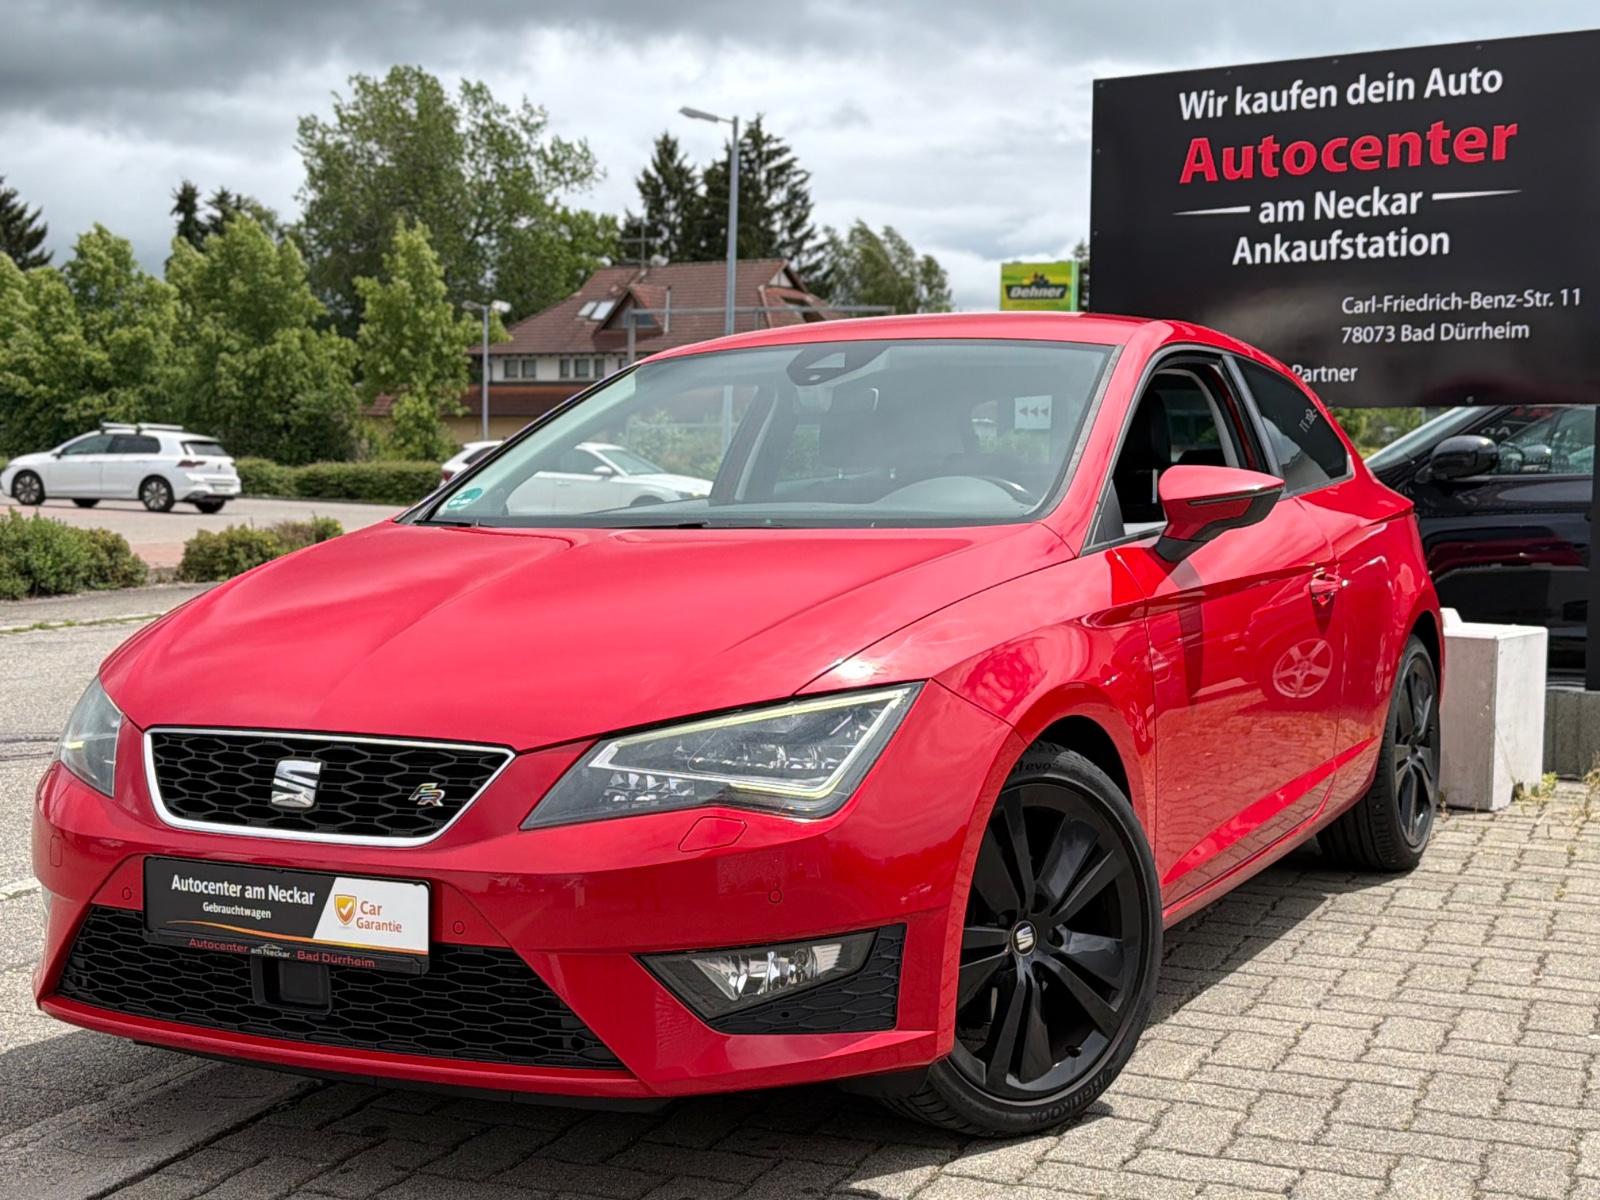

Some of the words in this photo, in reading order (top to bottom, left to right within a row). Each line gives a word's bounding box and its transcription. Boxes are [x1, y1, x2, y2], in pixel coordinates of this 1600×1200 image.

[1179, 89, 1228, 120] Wir
[1235, 79, 1338, 115] kaufen
[1346, 73, 1415, 105] dein
[1423, 66, 1503, 98] Auto
[1179, 120, 1518, 184] Autocenter
[1258, 199, 1305, 224] am
[1314, 185, 1423, 220] Neckar
[1232, 227, 1450, 266] Ankaufstation
[1009, 286, 1064, 298] Dehner
[1341, 289, 1554, 315] Carl-Friedrich-Benz-Str.
[1560, 288, 1581, 306] 11
[1341, 326, 1396, 344] 78073
[1400, 323, 1435, 342] Bad
[1440, 321, 1530, 341] Dürrheim
[1291, 364, 1358, 383] Partner
[171, 874, 242, 897] Autocenter
[244, 885, 265, 900] am
[268, 884, 316, 905] Neckar
[202, 901, 272, 920] Gebrauchtwagen
[360, 900, 383, 916] Car
[356, 917, 403, 933] Garantie
[189, 938, 248, 953] Autocenter
[263, 947, 290, 958] Neckar
[297, 950, 319, 962] Bad
[322, 952, 375, 968] Dürrheim
